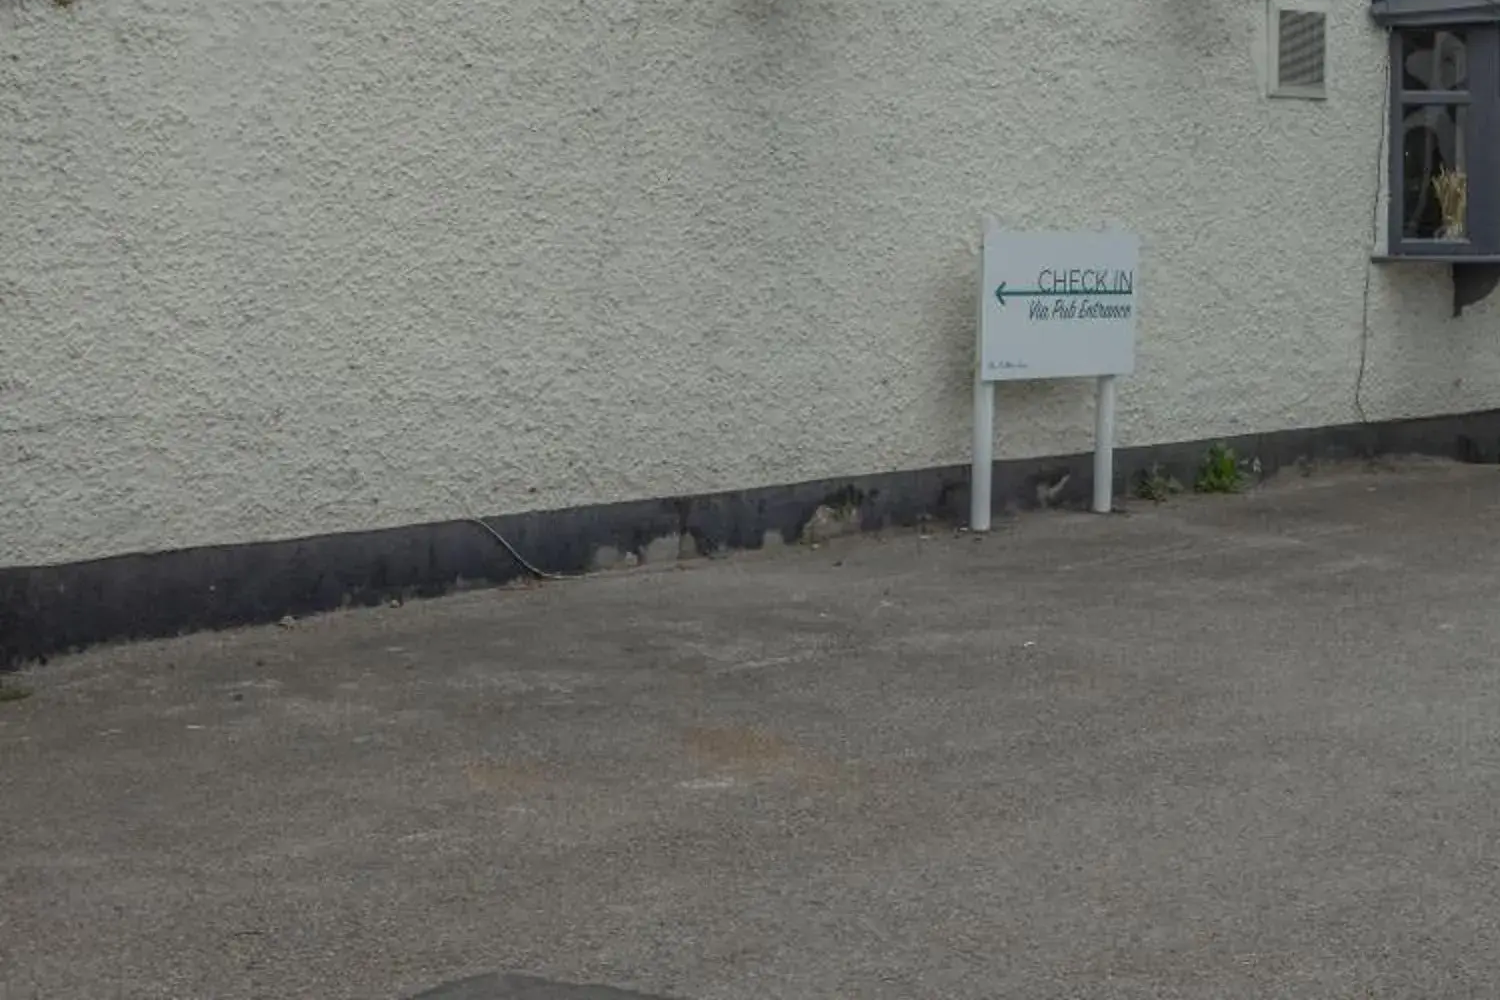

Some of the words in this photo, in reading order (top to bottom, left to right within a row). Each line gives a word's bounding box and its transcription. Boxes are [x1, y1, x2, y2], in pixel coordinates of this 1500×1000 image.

[1038, 269, 1108, 294] CHECK
[1113, 269, 1133, 294] IN
[1028, 299, 1049, 320] Via
[1052, 299, 1077, 320] Pub
